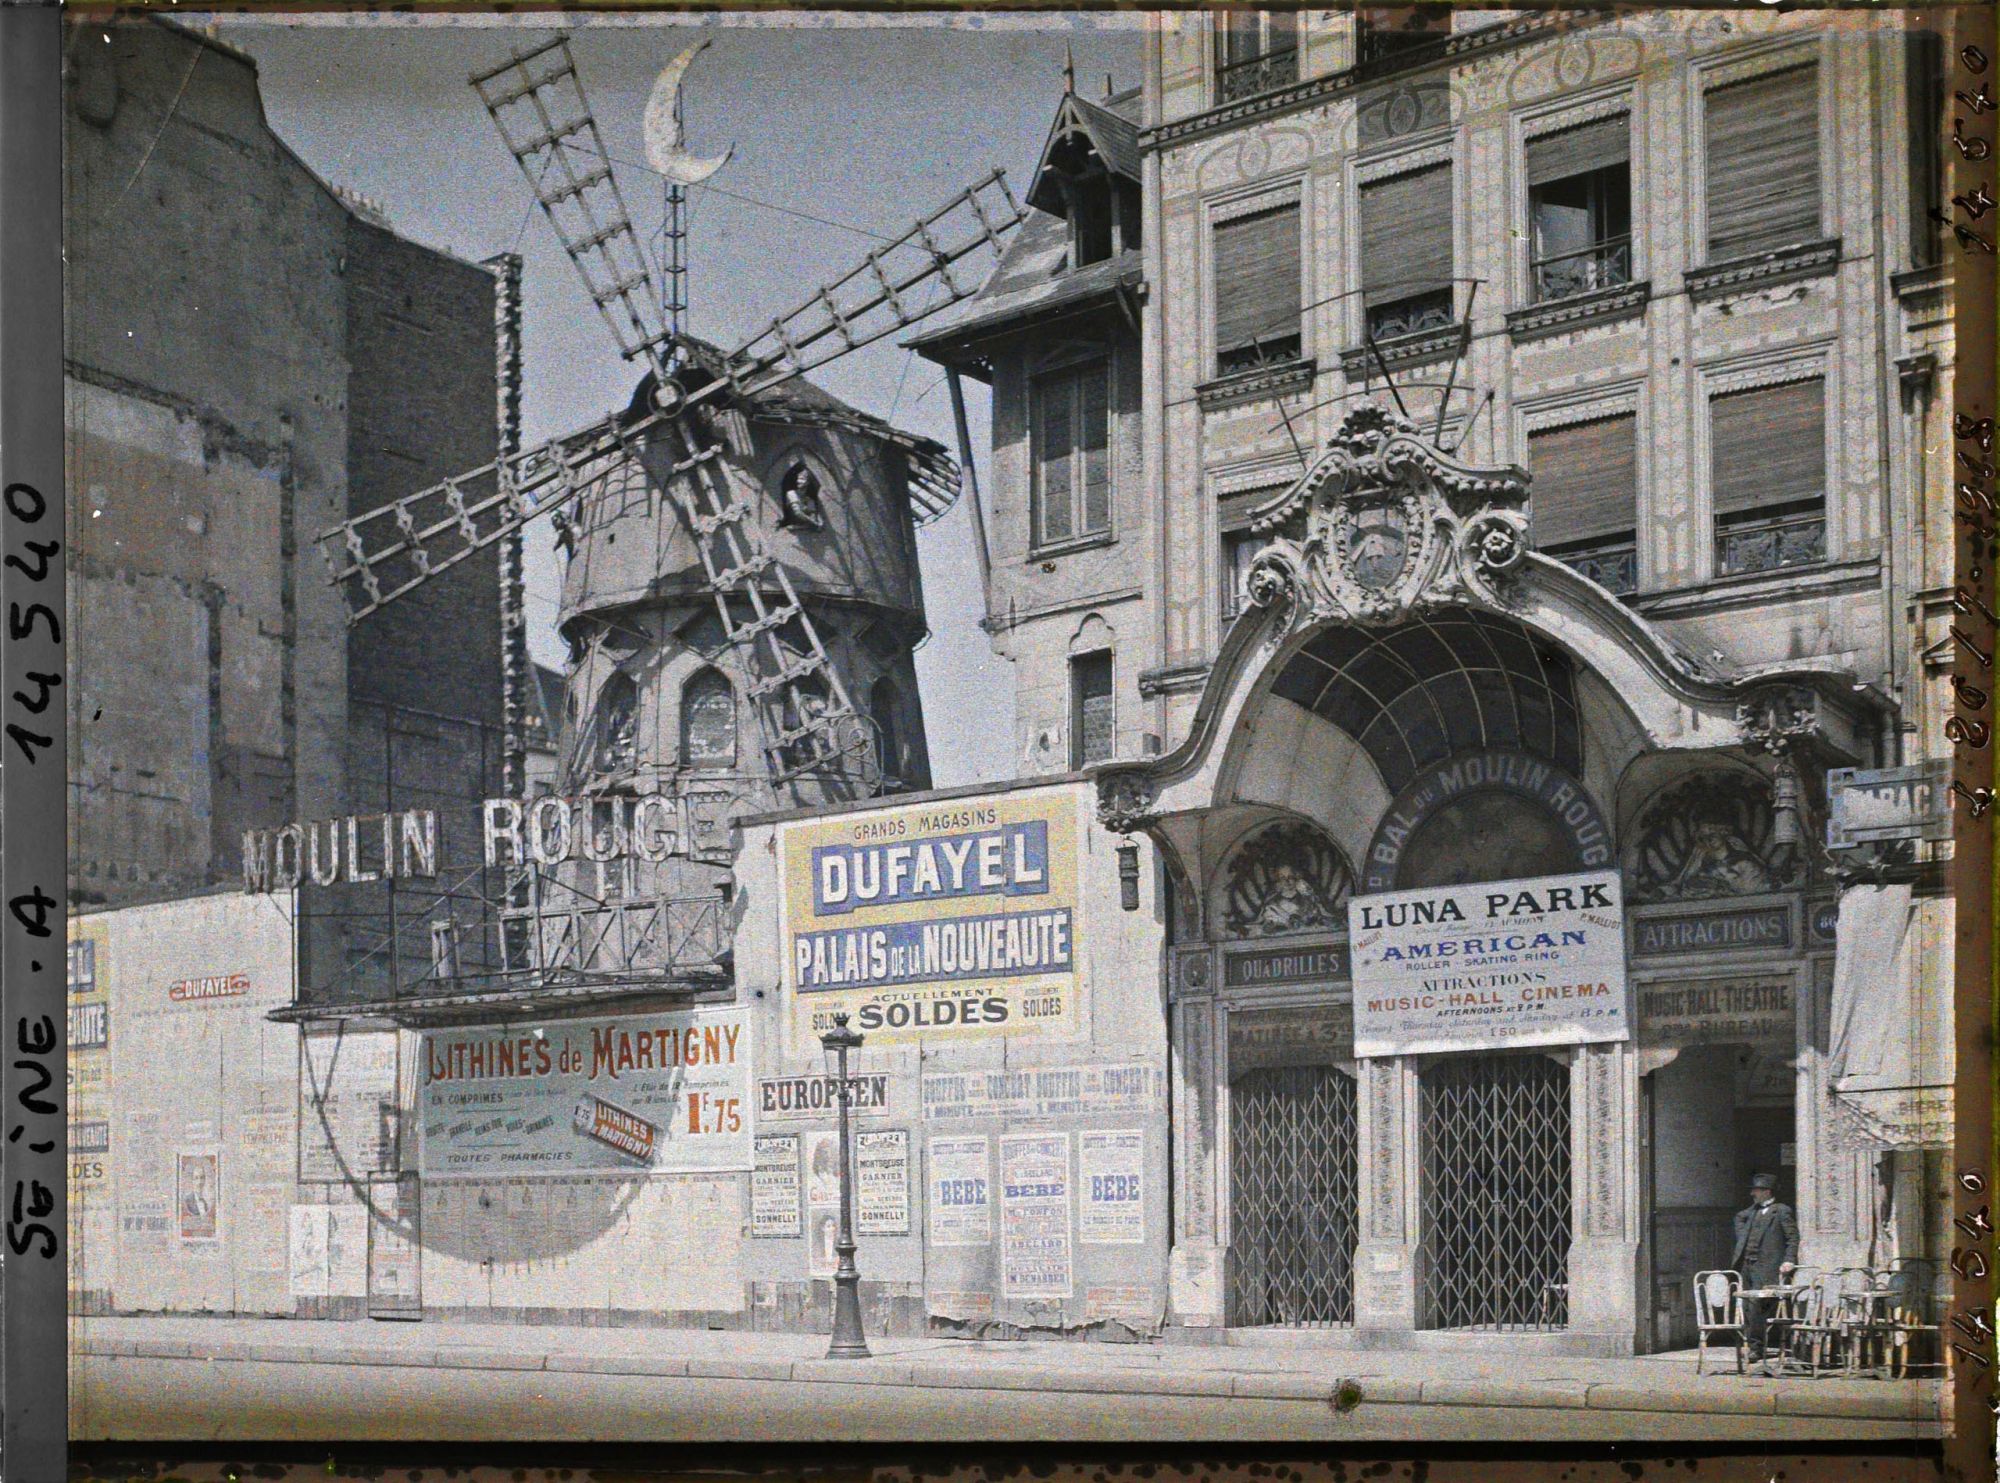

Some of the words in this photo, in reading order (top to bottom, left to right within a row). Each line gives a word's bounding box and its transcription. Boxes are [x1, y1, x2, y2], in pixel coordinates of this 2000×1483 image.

[4, 482, 62, 766] 14540
[853, 819, 907, 841] GRANDS
[918, 808, 997, 832] MAGASINS
[1437, 754, 1549, 795] MOULIN
[1550, 781, 1609, 867] ROUG
[241, 808, 436, 896] MOULIN
[483, 791, 733, 869] ROUGE
[821, 832, 1044, 904] DUFAYEL
[1360, 898, 1467, 930] LUNA
[1485, 883, 1614, 918] PARK
[1380, 930, 1587, 963] AMERICAN
[1644, 915, 1783, 947] ATTRACTIONS
[796, 930, 888, 986] PALAIS
[891, 946, 905, 977] DE
[908, 944, 920, 976] LA
[1242, 953, 1340, 982] QUADRILLES
[1405, 960, 1451, 972] ROLLER
[1464, 954, 1519, 968] SKATING
[1524, 950, 1561, 962] RING
[184, 976, 233, 998] DUFAYEL
[871, 988, 994, 1004] ACTUELLEMENT
[1419, 973, 1548, 993] ATTRACTIONS
[1520, 982, 1612, 1002] CINEMA
[859, 996, 1010, 1030] SOLDES
[1022, 997, 1062, 1018] SOLDES
[559, 1037, 583, 1074] de
[589, 1023, 741, 1082] MARTIGNY
[600, 1125, 651, 1157] MARTIGNY
[447, 1153, 492, 1164] TOUTES
[500, 1151, 574, 1162] PHARMACIES
